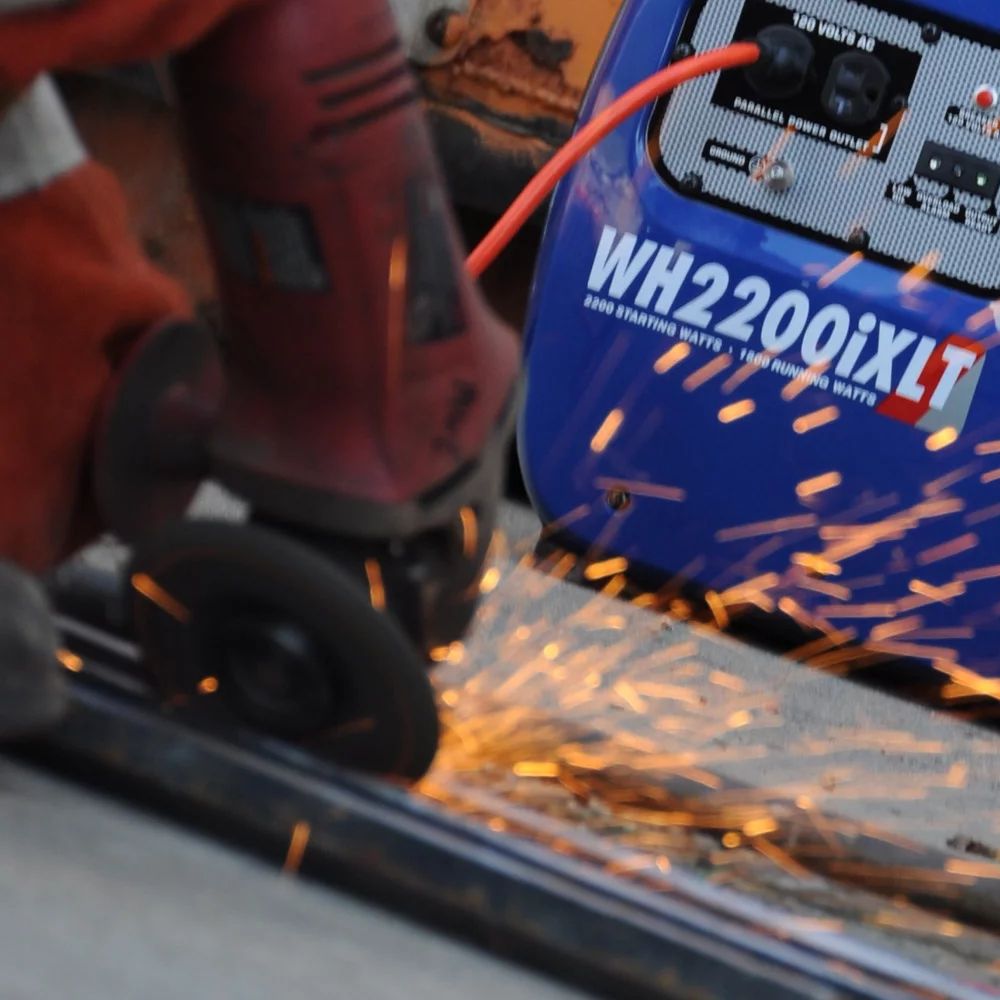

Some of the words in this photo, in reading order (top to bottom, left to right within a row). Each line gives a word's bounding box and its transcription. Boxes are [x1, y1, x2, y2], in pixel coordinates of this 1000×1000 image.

[732, 96, 786, 124] PARALLEL
[786, 115, 827, 138] POWER
[583, 293, 615, 315] 2200
[614, 302, 678, 337] STARTING
[676, 324, 723, 352] WATTS
[770, 357, 830, 390] RUNNING
[830, 379, 878, 408] WATTS
